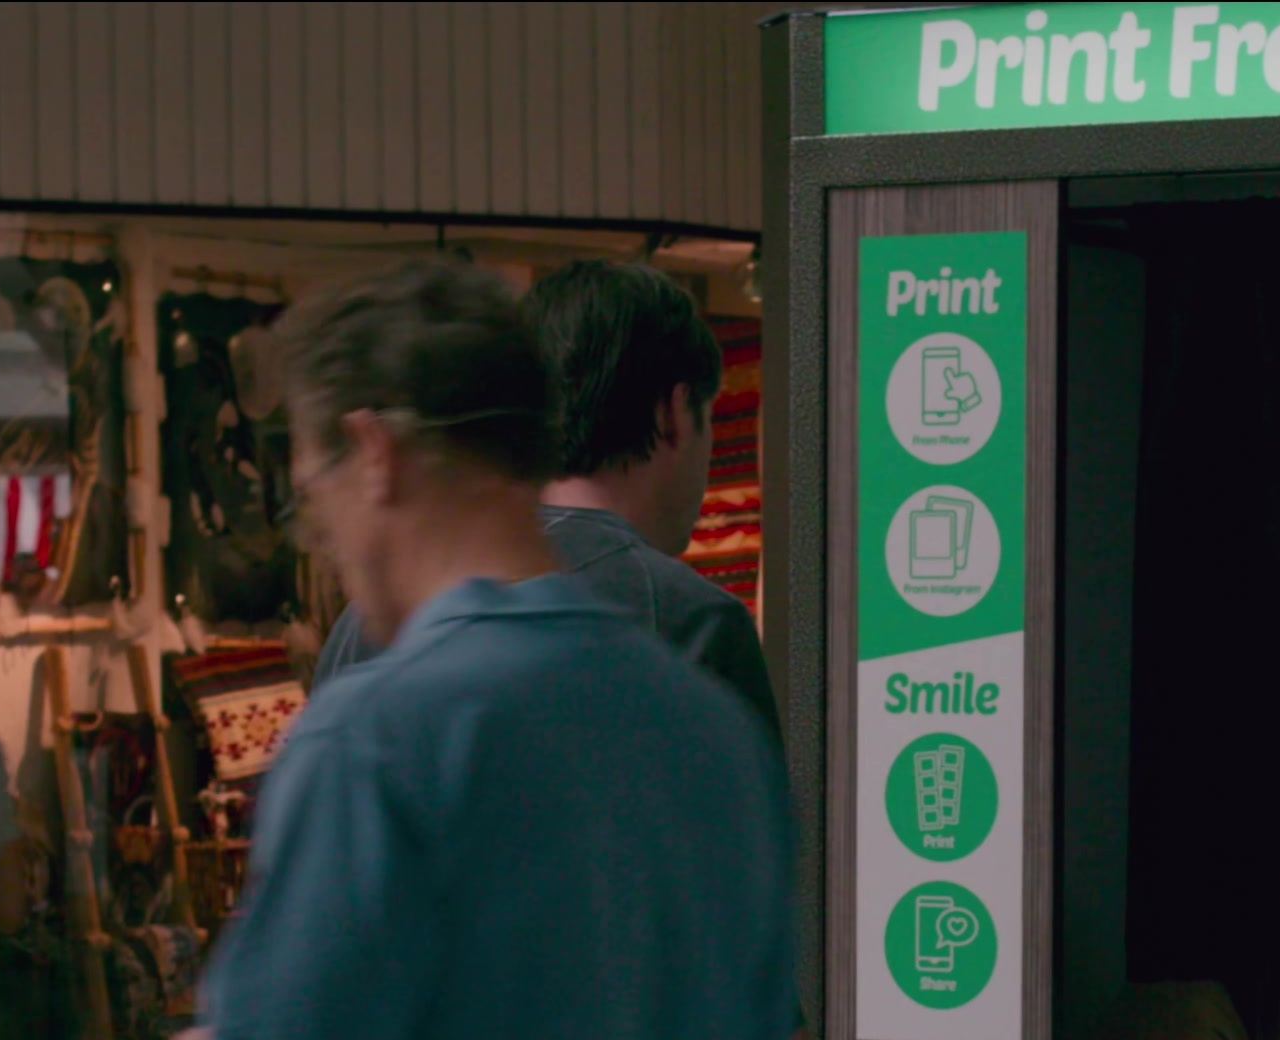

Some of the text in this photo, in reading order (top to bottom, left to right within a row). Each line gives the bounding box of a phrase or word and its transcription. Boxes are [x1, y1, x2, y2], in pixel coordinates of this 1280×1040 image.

[918, 9, 1152, 112] Print
[886, 266, 1002, 317] Print
[884, 671, 1000, 715] Smile
[923, 834, 955, 849] Print
